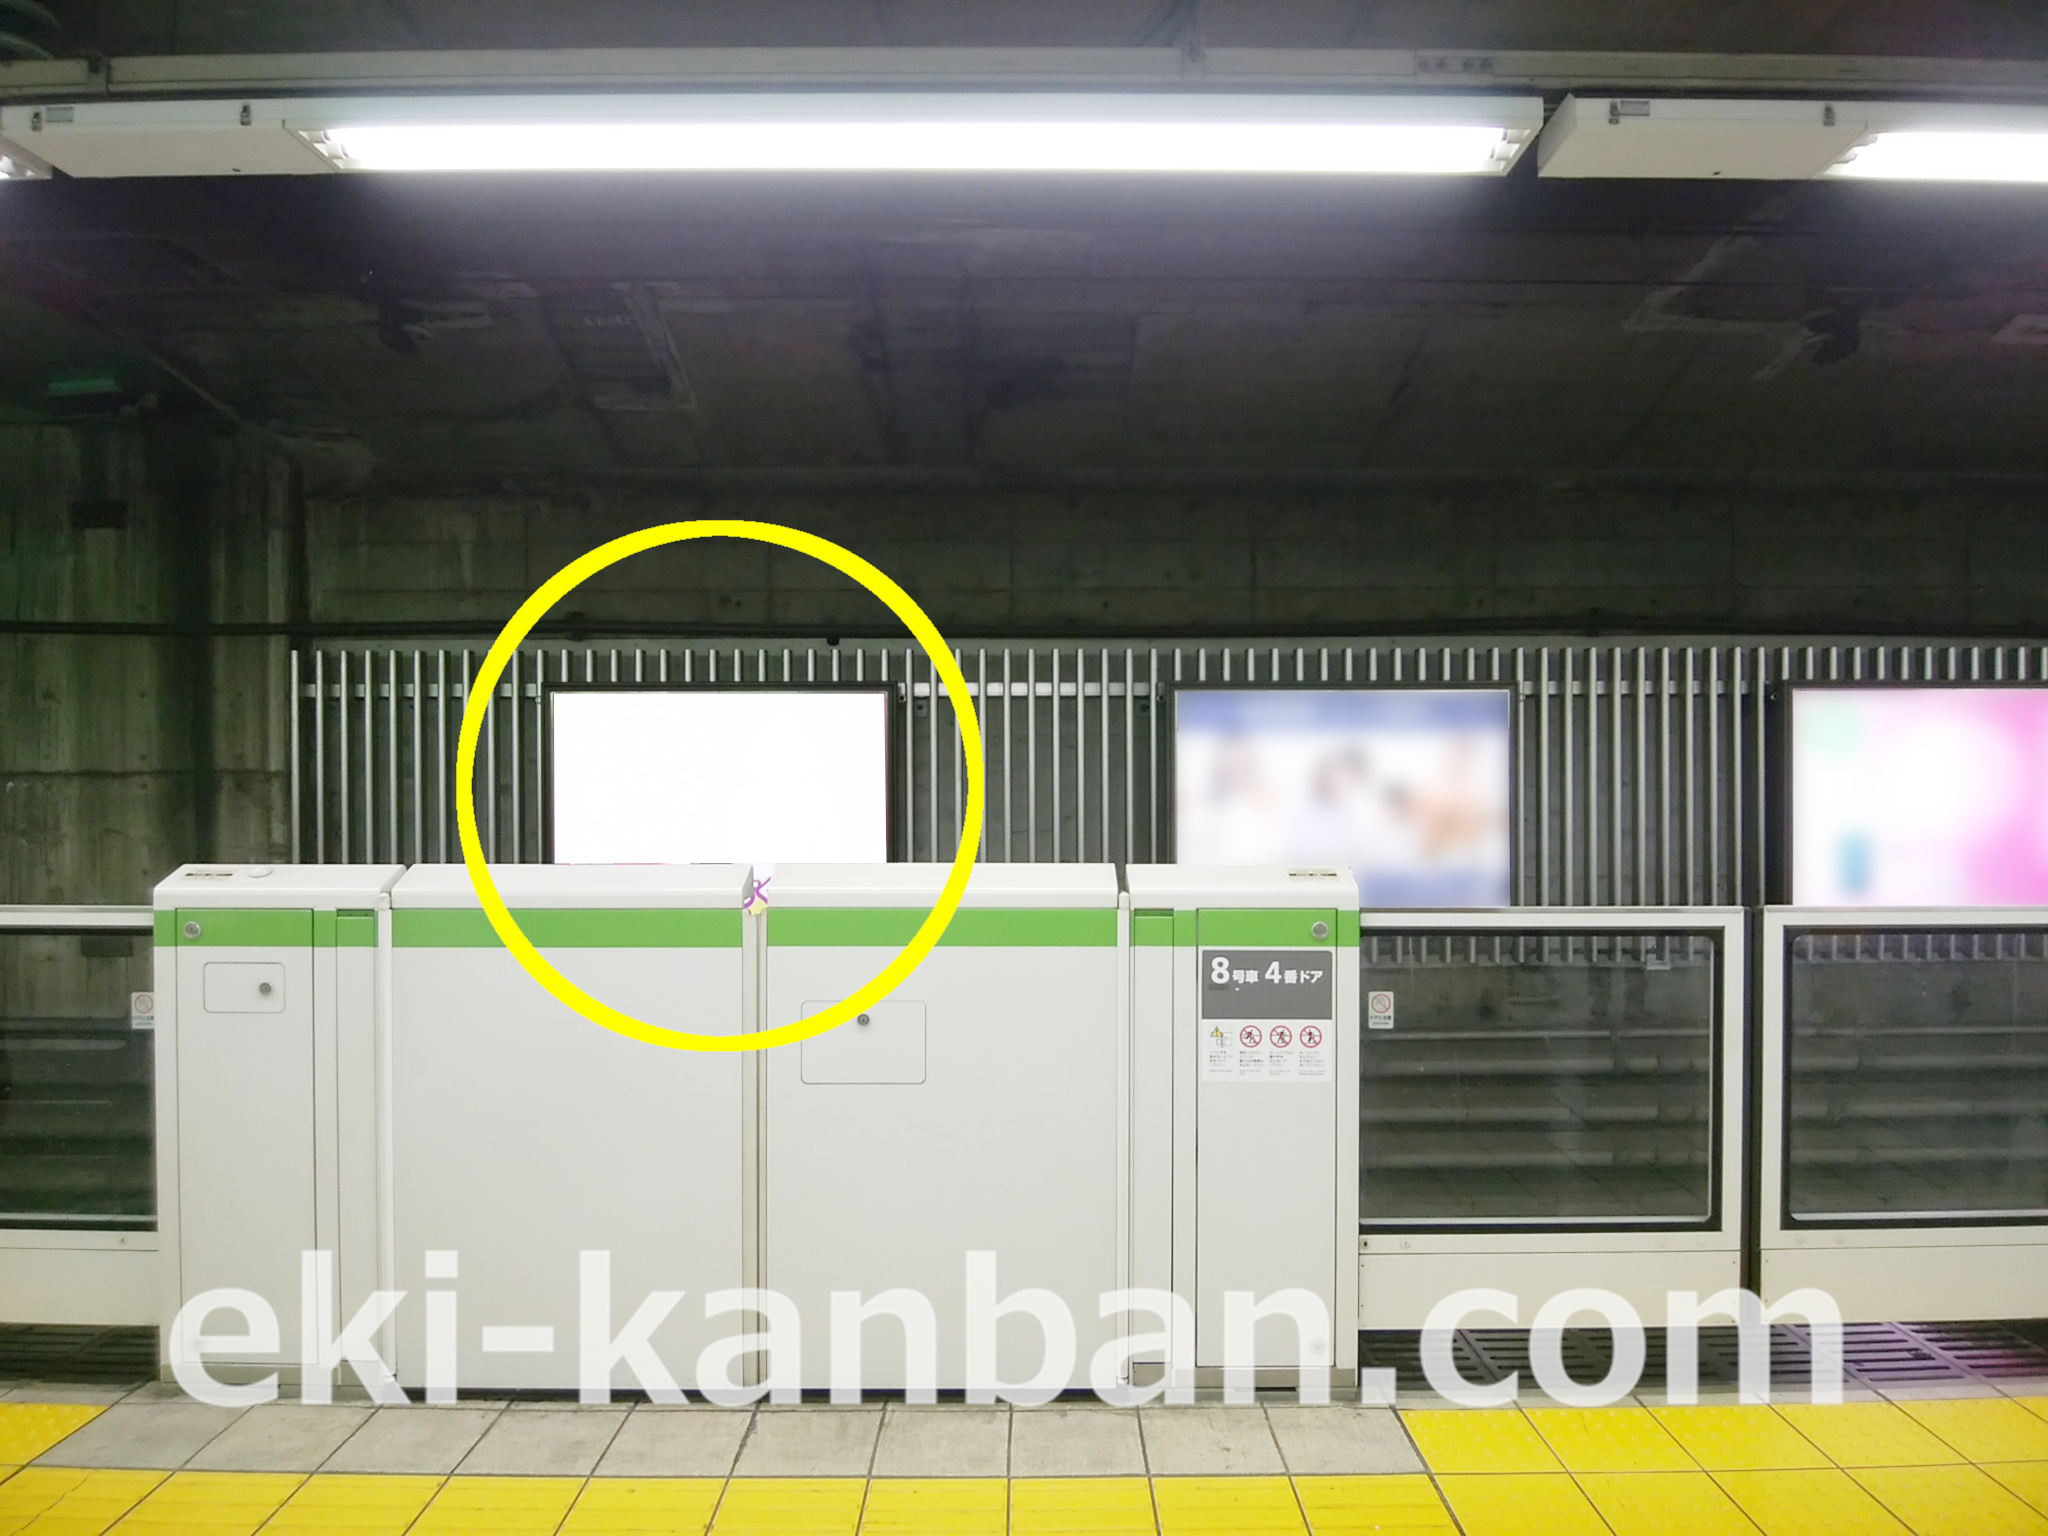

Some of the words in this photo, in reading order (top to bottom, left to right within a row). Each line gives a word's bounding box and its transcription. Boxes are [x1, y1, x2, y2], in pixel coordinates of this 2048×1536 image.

[1211, 956, 1259, 984] 8号車
[1265, 961, 1323, 984] 4番ドア
